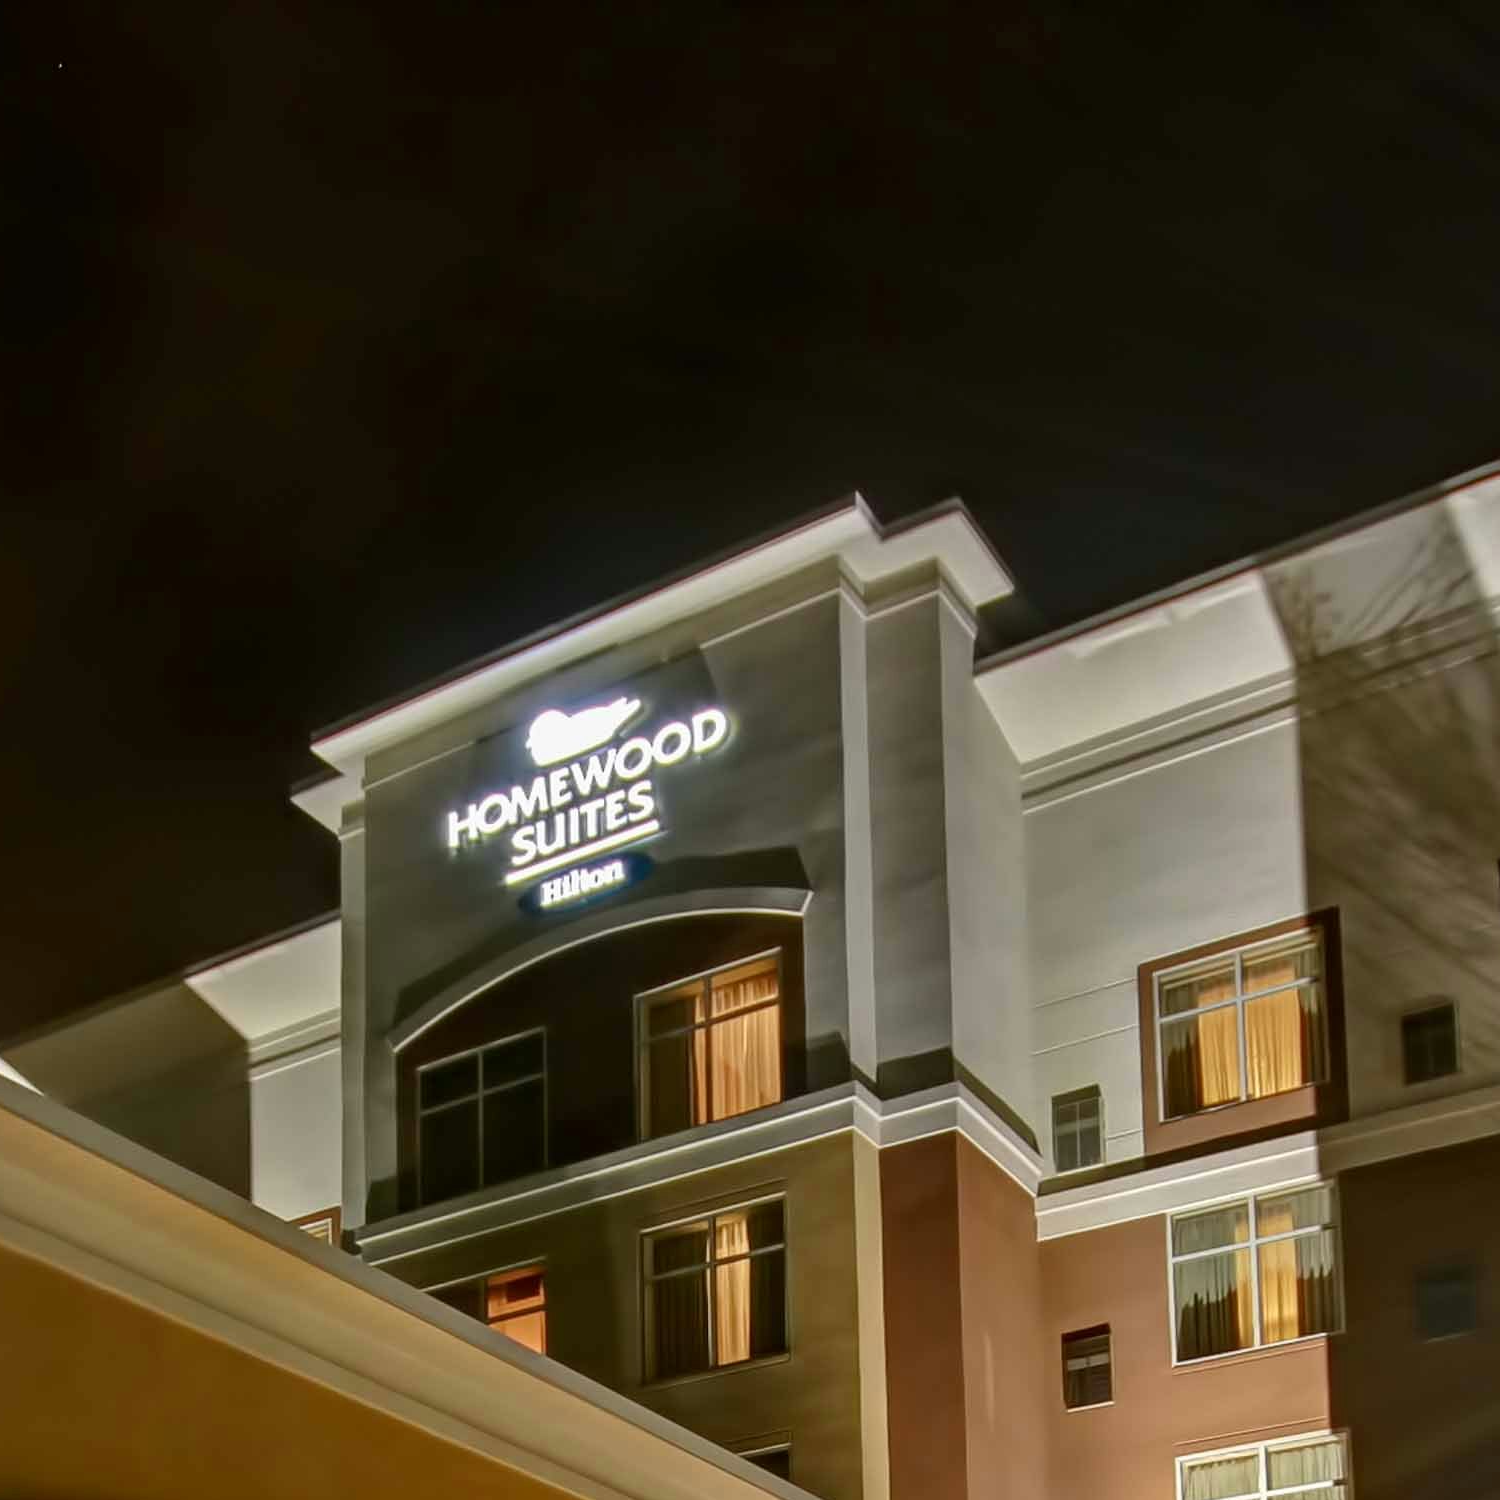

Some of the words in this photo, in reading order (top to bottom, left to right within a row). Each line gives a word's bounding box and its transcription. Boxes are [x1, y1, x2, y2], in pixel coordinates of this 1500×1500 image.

[448, 709, 727, 848] HOMEWOOD
[511, 780, 655, 866] SUITES
[540, 860, 626, 907] Hilton
